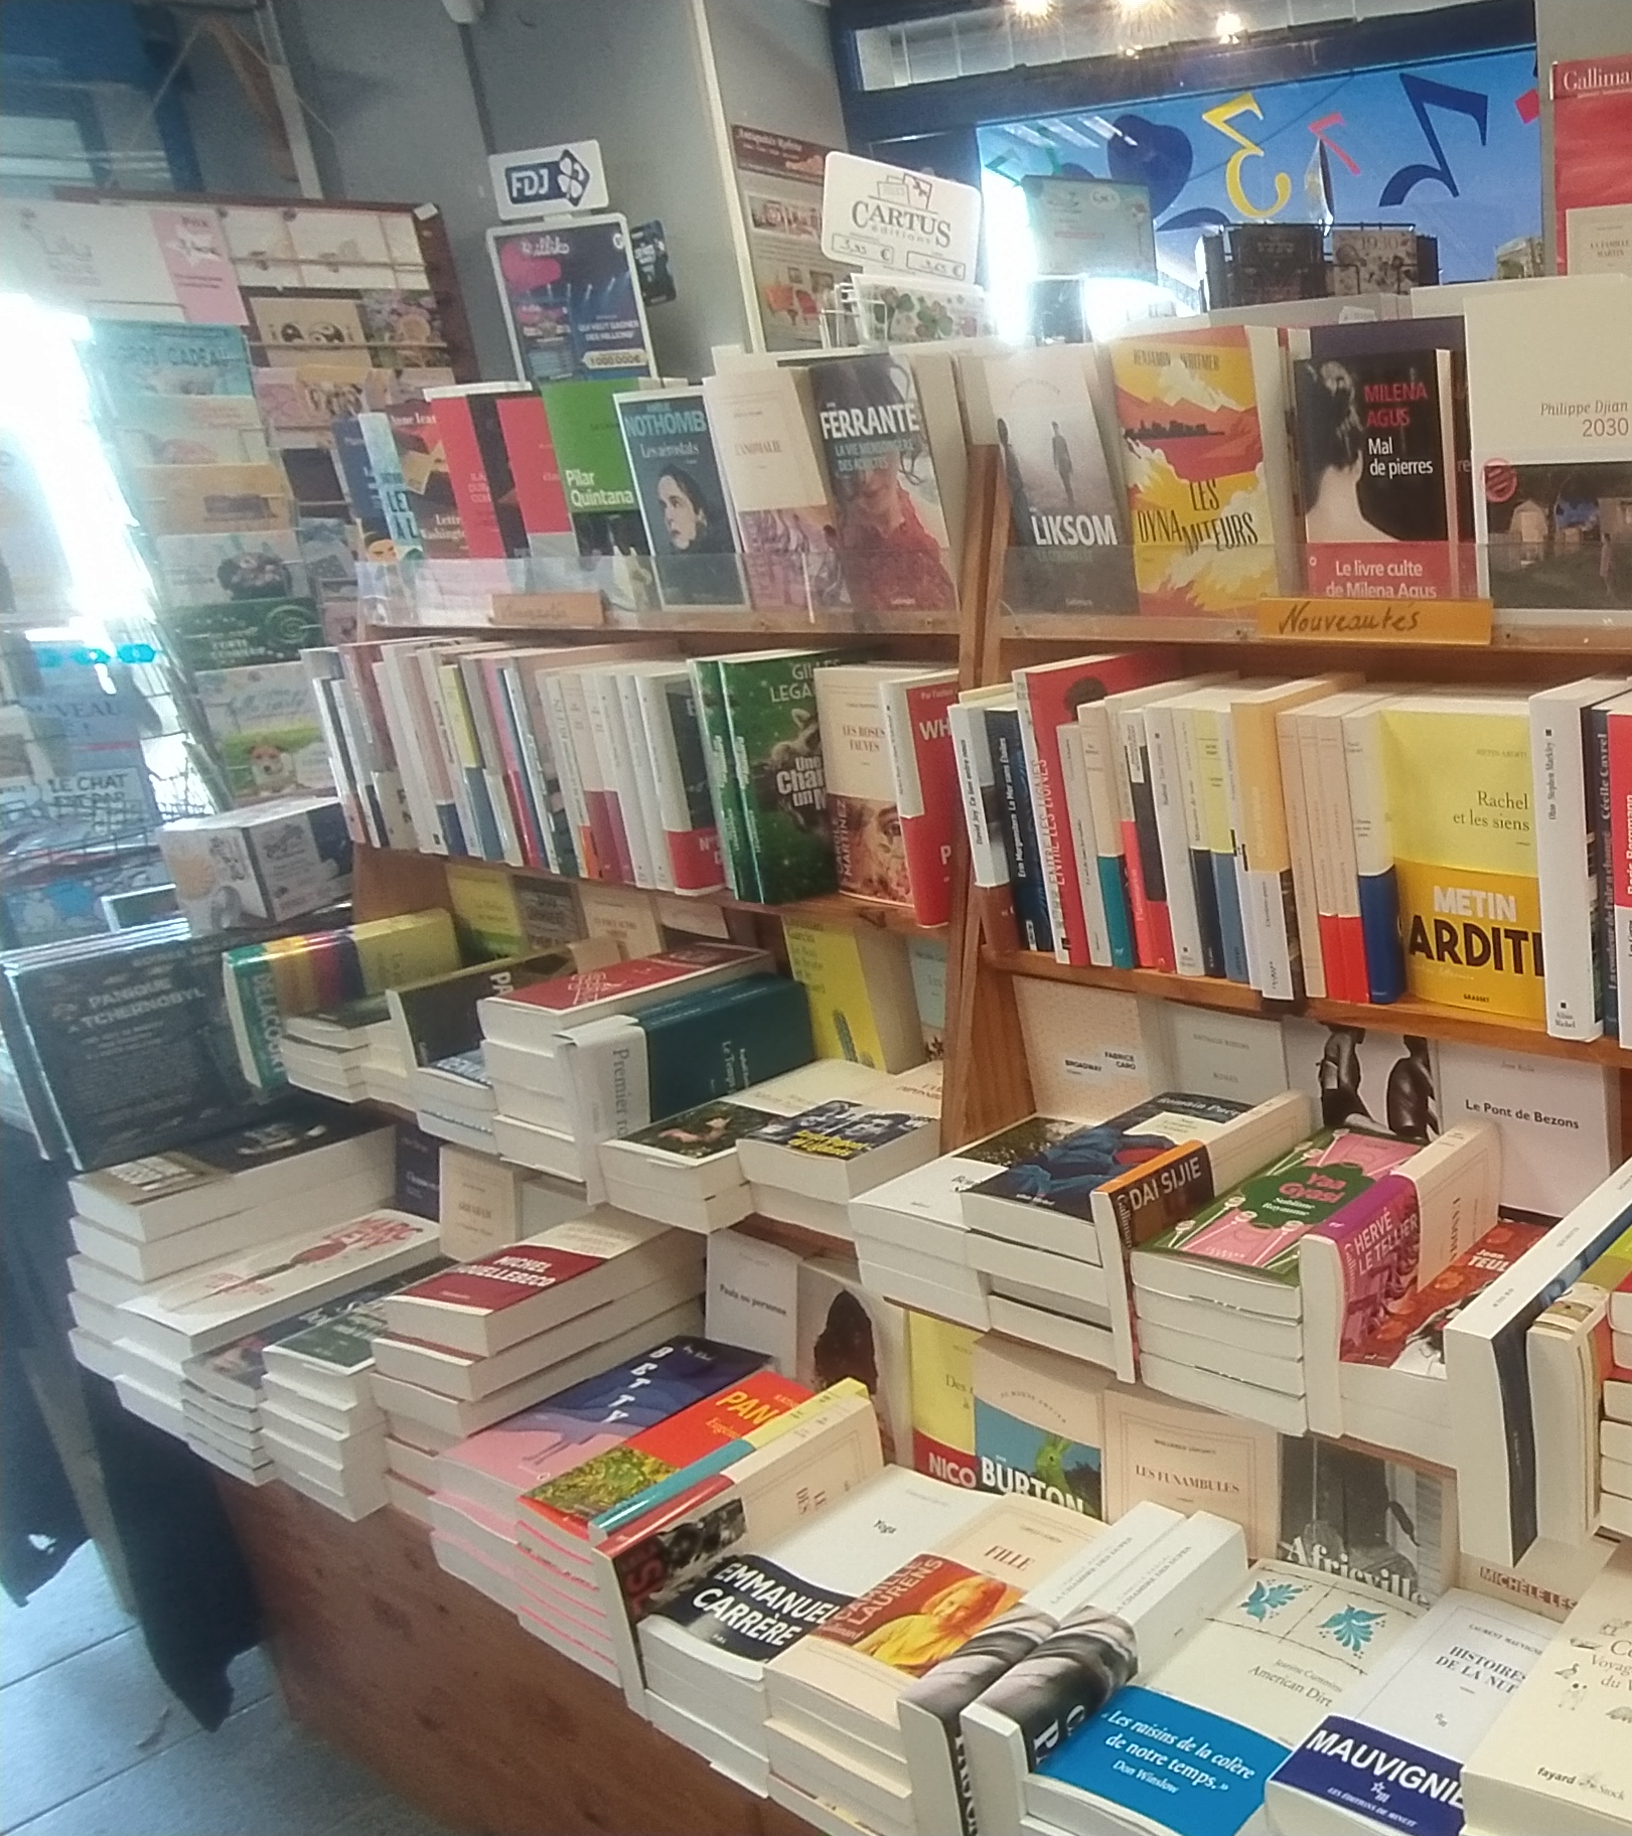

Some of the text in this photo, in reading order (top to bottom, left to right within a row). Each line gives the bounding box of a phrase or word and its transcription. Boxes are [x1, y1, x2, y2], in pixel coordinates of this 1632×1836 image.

[511, 168, 549, 198] FDJ
[852, 200, 951, 248] CARTUS
[1364, 381, 1428, 403] MILENA
[624, 410, 708, 438] NOTHOMB
[819, 402, 920, 440] FERRANTE
[1366, 408, 1411, 429] AGUS
[1540, 401, 1629, 419] Philippe Djian
[1582, 417, 1630, 437] 2030
[1368, 437, 1393, 456] Mal
[566, 469, 596, 487] Pilar
[1369, 458, 1434, 478] de pierres
[570, 488, 634, 508] Quintana
[1190, 479, 1220, 513] LES
[1030, 514, 1118, 547] LIKSOM
[1335, 559, 1423, 578] Le livre culte
[1279, 601, 1420, 634] Nouveautés
[1477, 790, 1529, 811] Rachel
[1453, 811, 1531, 832] et les siens
[1433, 885, 1516, 922] METIN
[1408, 914, 1545, 978] ARDITI
[1104, 1051, 1135, 1063] FABRICE
[1115, 1060, 1136, 1071] CARO
[1465, 1099, 1580, 1130] Le Pont de Bezons
[1130, 1157, 1202, 1212] DAI SIJIE
[1353, 1206, 1392, 1255] HERVÉ
[493, 1255, 552, 1274] MICHEL
[1478, 1248, 1506, 1260] Jean
[928, 1450, 977, 1490] NICO
[1135, 1465, 1241, 1496] LES FUNAMBULES
[872, 1519, 897, 1535] Yoga
[984, 1545, 1032, 1572] FILLE
[713, 1561, 842, 1626] EMMANUEL
[833, 1559, 926, 1622] CAMILLE
[852, 1558, 943, 1625] LAURENS
[692, 1588, 802, 1647] CARRÈRE
[1249, 1663, 1334, 1709] American Dirt
[1601, 1673, 1622, 1690] du
[1113, 1760, 1180, 1795] Don Winslow
[1536, 1766, 1626, 1802] fayard Stock
